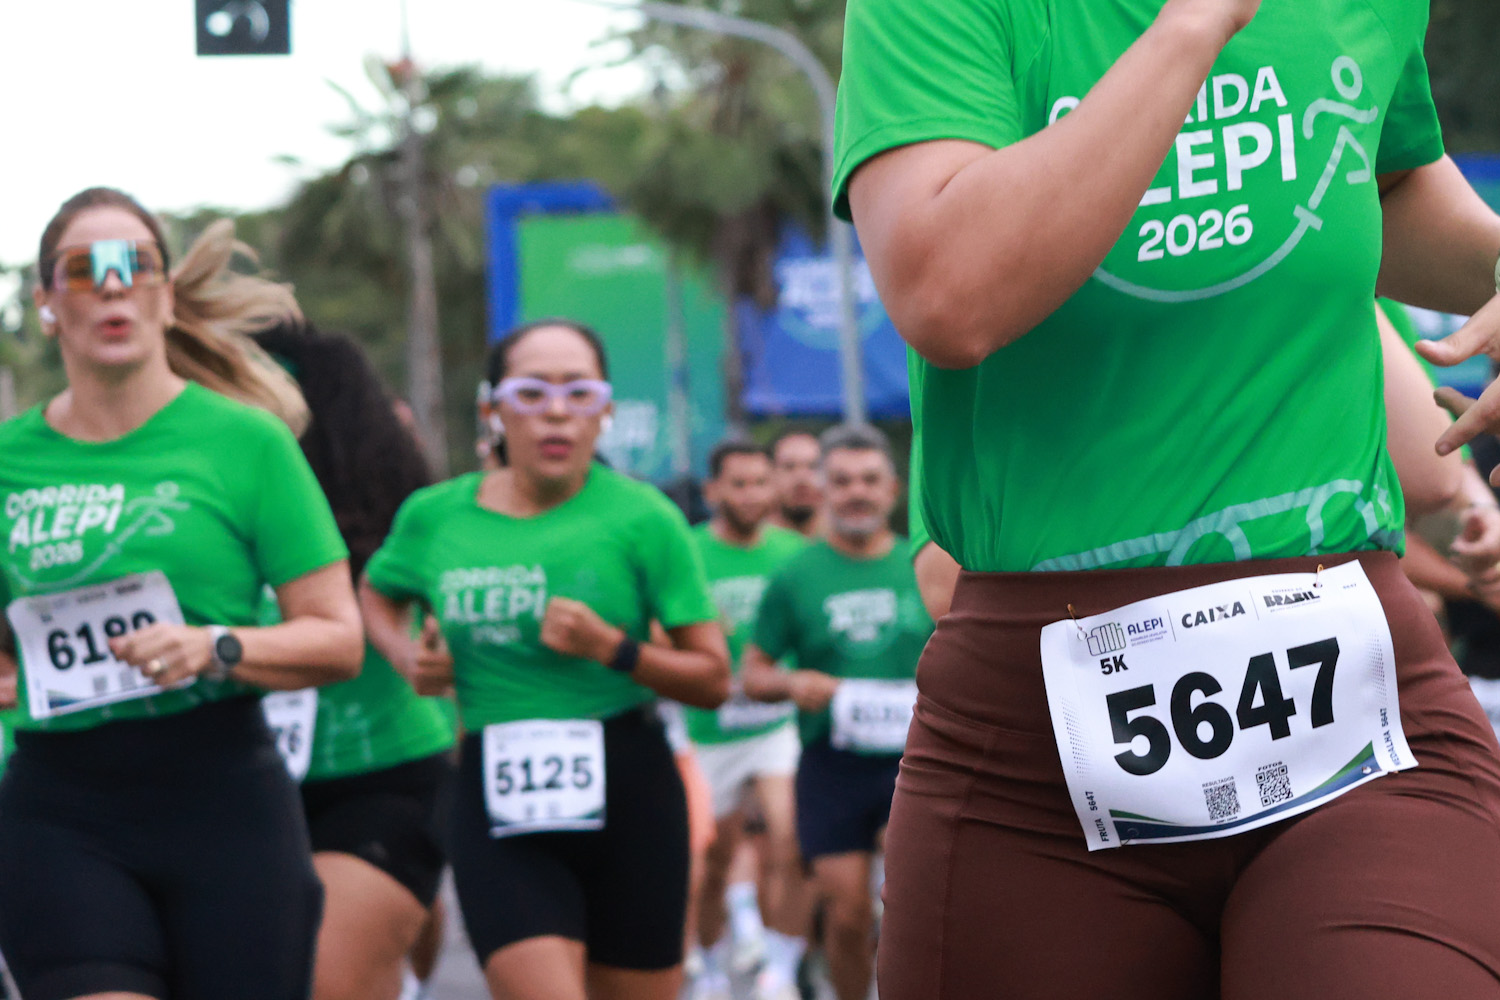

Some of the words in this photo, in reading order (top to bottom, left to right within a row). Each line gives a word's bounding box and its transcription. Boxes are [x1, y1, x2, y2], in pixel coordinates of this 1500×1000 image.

[1137, 204, 1254, 262] 2026
[5, 483, 125, 518] CORRIDA
[9, 504, 122, 554] ALEPI
[30, 539, 83, 571] 2026
[1263, 590, 1320, 608] BRASIL
[1127, 617, 1163, 635] ALEPI
[1181, 601, 1246, 629] CAIXA
[1100, 653, 1129, 675] 5K
[1105, 637, 1340, 776] 5647
[496, 754, 592, 795] 5125
[1258, 761, 1283, 771] FOTOS
[1085, 791, 1098, 811] 5647
[1094, 818, 1109, 842] FRUTA
